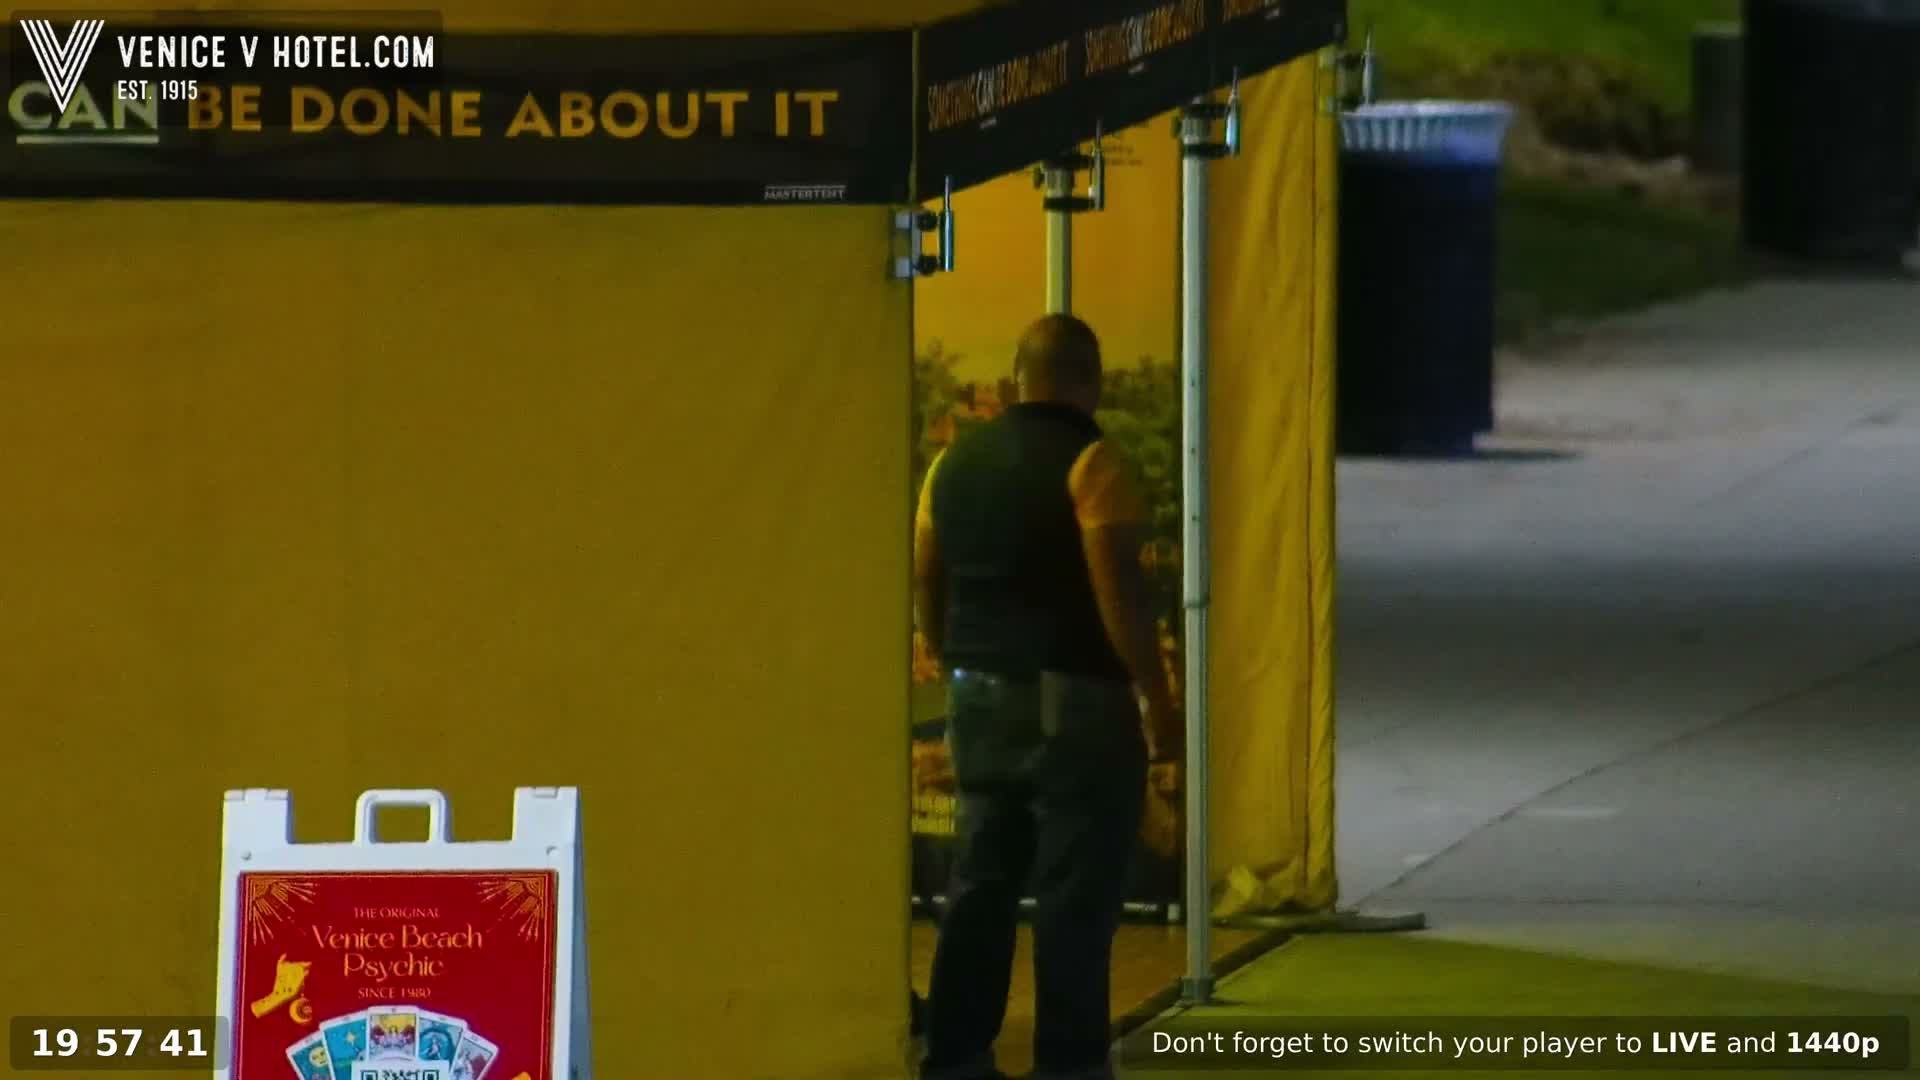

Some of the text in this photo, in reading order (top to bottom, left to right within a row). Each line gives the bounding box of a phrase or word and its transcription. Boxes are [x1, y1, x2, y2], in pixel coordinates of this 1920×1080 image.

[8, 81, 839, 139] CAN BE DONE ABOUT IT
[354, 907, 441, 919] THE ORIGINAL
[312, 923, 483, 949] Venice Beach
[344, 951, 444, 982] Psychic
[358, 987, 431, 999] SINCE 1980
